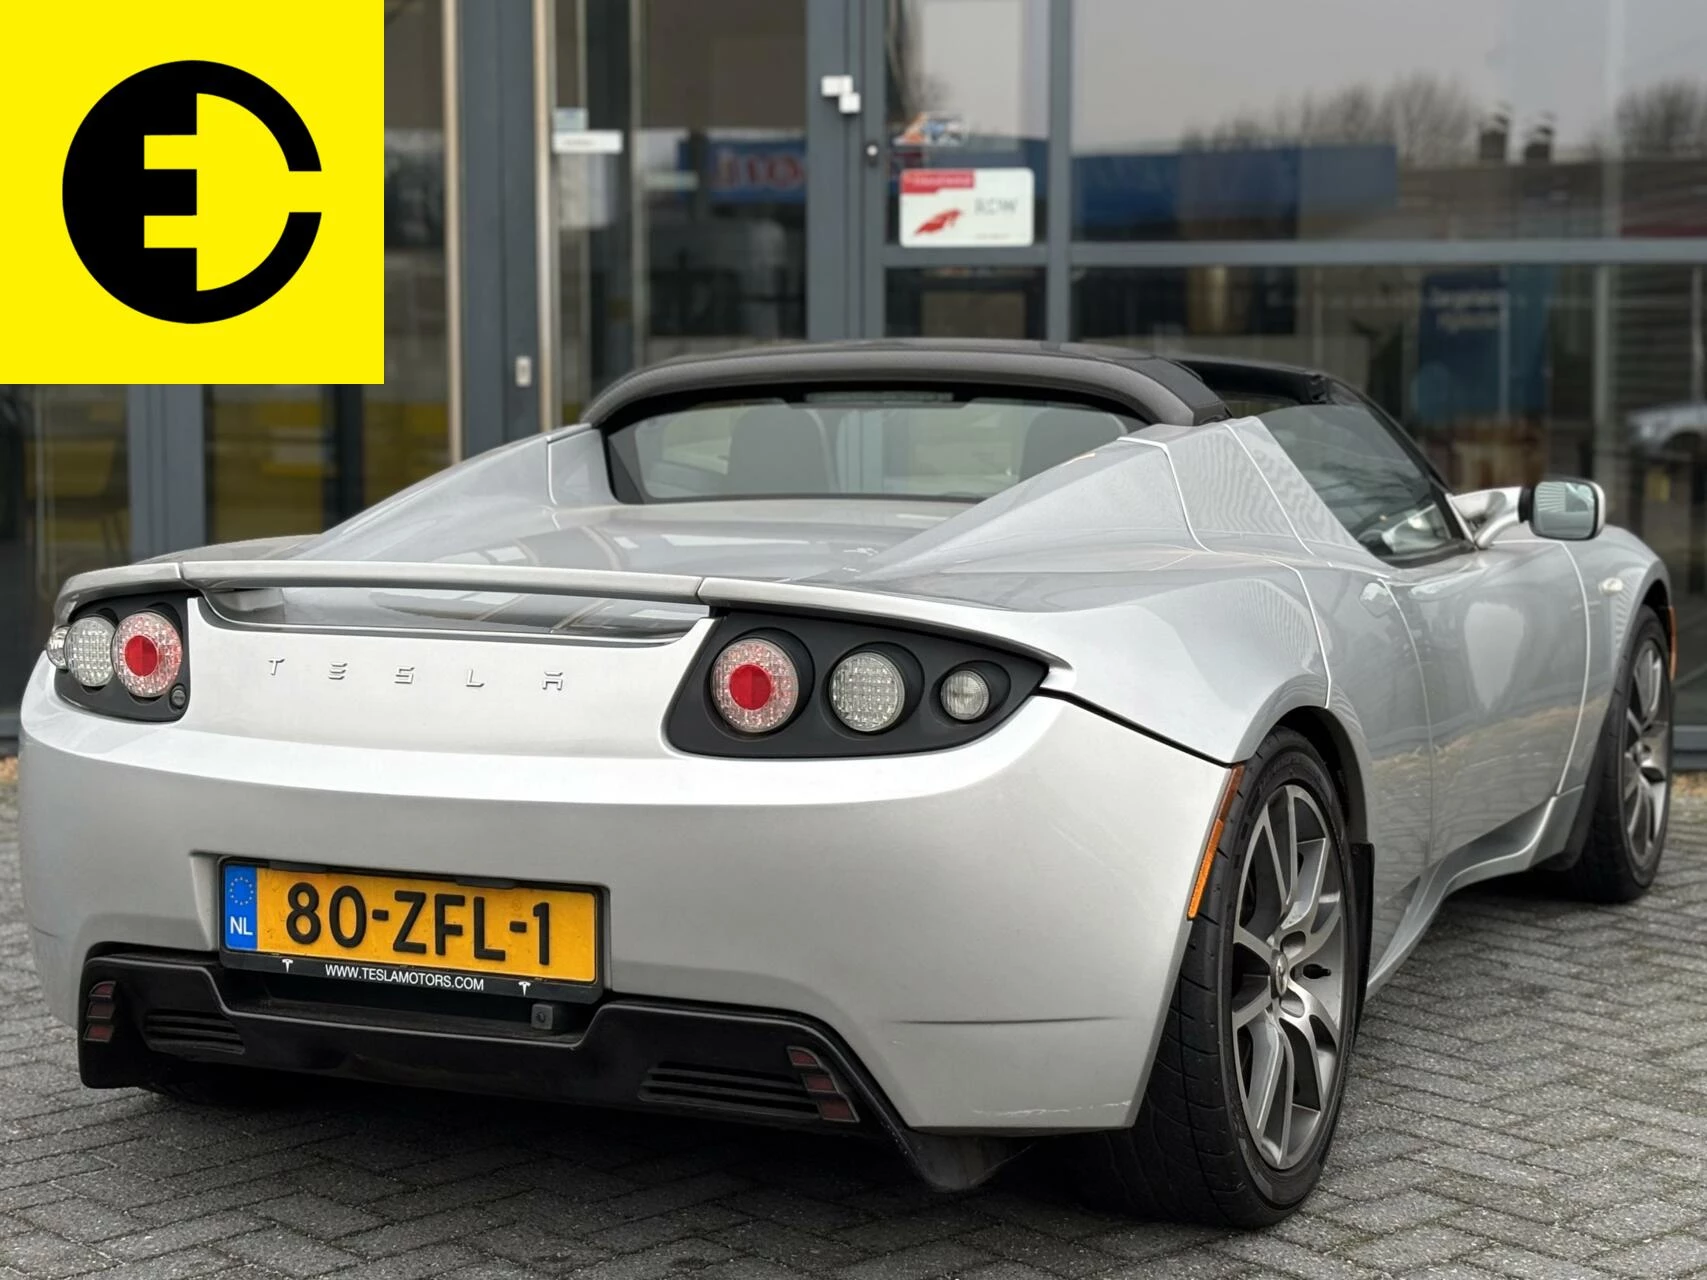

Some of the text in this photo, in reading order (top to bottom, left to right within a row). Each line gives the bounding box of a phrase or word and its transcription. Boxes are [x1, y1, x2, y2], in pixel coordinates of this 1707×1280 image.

[268, 657, 564, 691] TESLA
[229, 917, 254, 937] NL
[285, 881, 551, 966] 80-ZFL-1
[324, 963, 485, 991] WWW.TESLAMOTORS.COM
